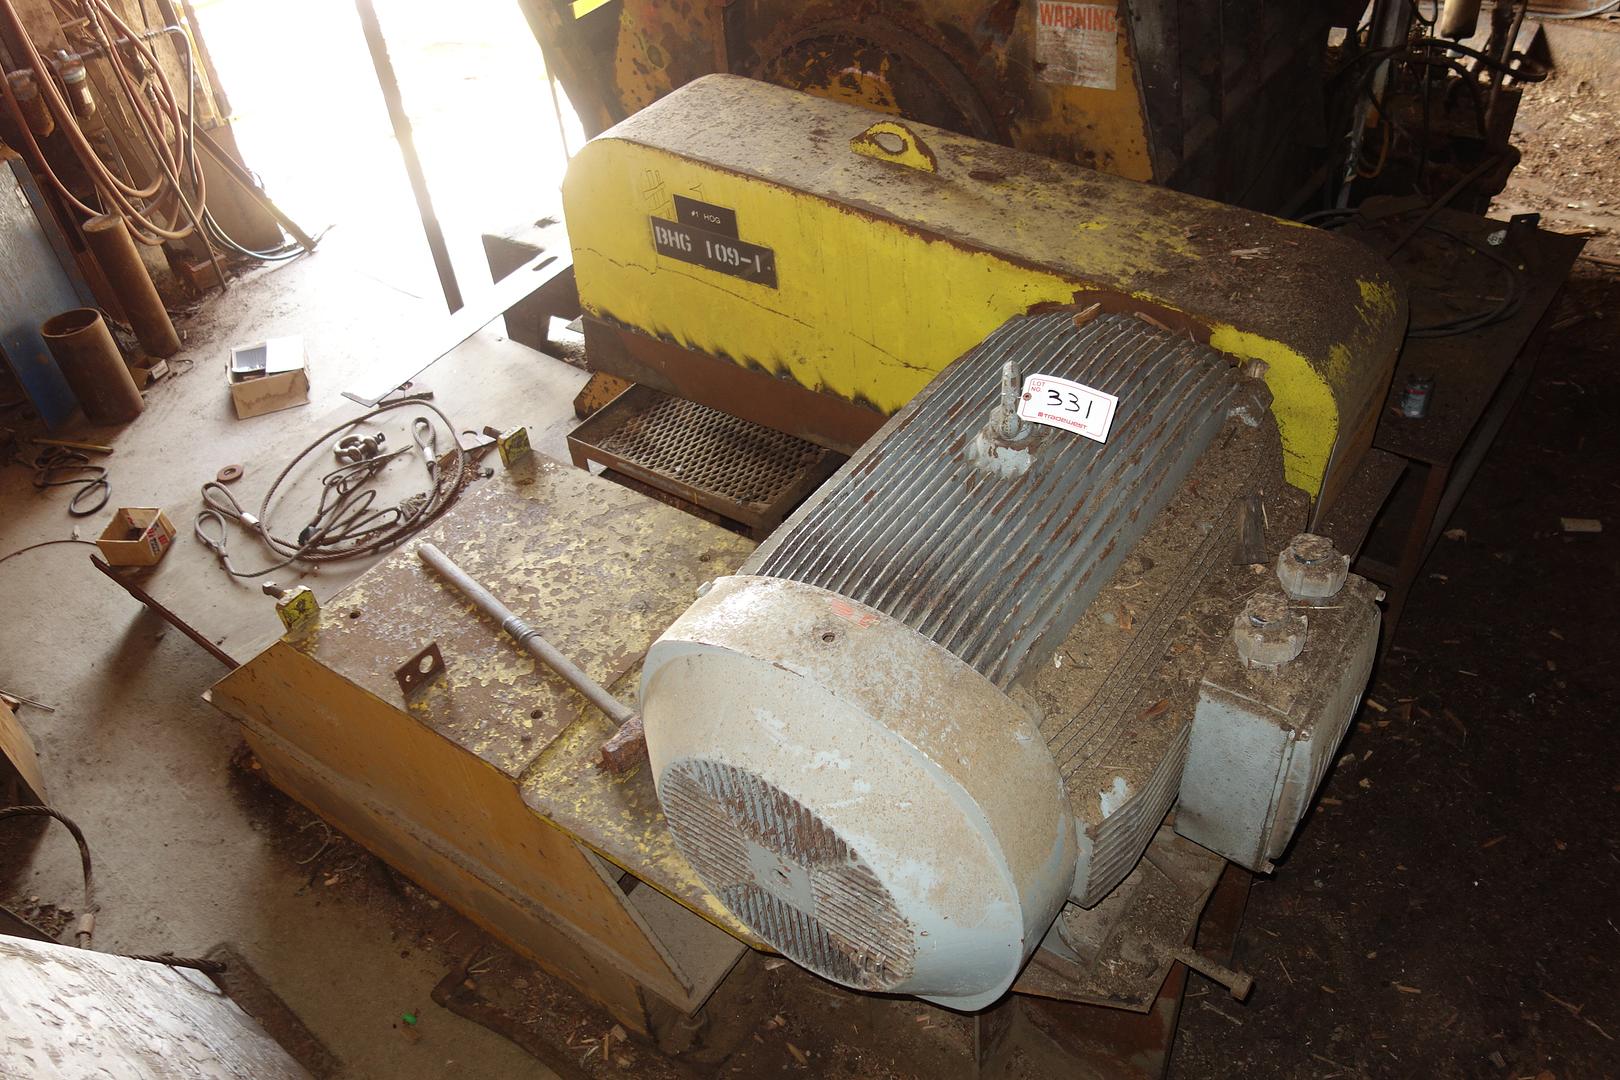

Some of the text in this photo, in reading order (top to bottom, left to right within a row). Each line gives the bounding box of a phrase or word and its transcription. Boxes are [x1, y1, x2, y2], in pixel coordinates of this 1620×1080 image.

[1040, 3, 1117, 32] WARNING
[703, 213, 721, 224] HOG
[655, 225, 761, 273] BHG 109-1
[1047, 389, 1093, 419] 331
